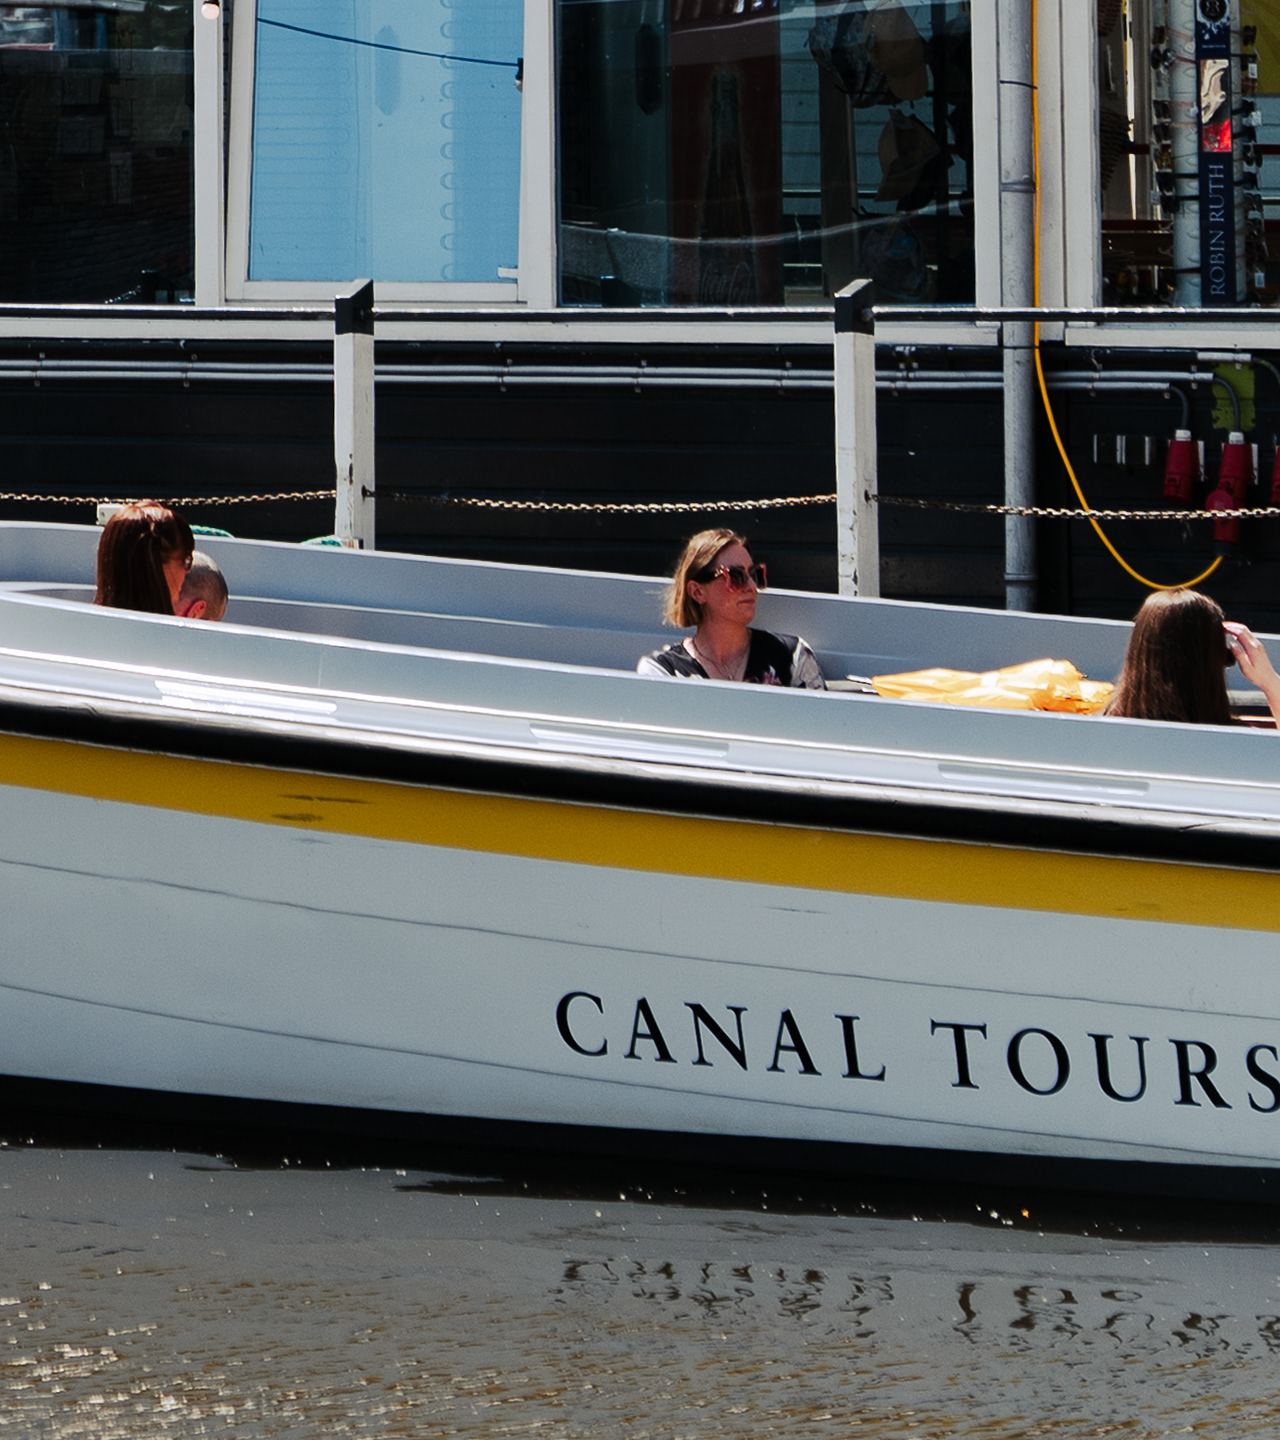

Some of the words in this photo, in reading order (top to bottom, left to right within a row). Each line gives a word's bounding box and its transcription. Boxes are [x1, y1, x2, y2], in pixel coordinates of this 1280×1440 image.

[1208, 164, 1226, 222] RUTH
[1209, 229, 1226, 297] ROBIN
[554, 991, 887, 1082] CANAL
[930, 1019, 1280, 1113] TOURS
